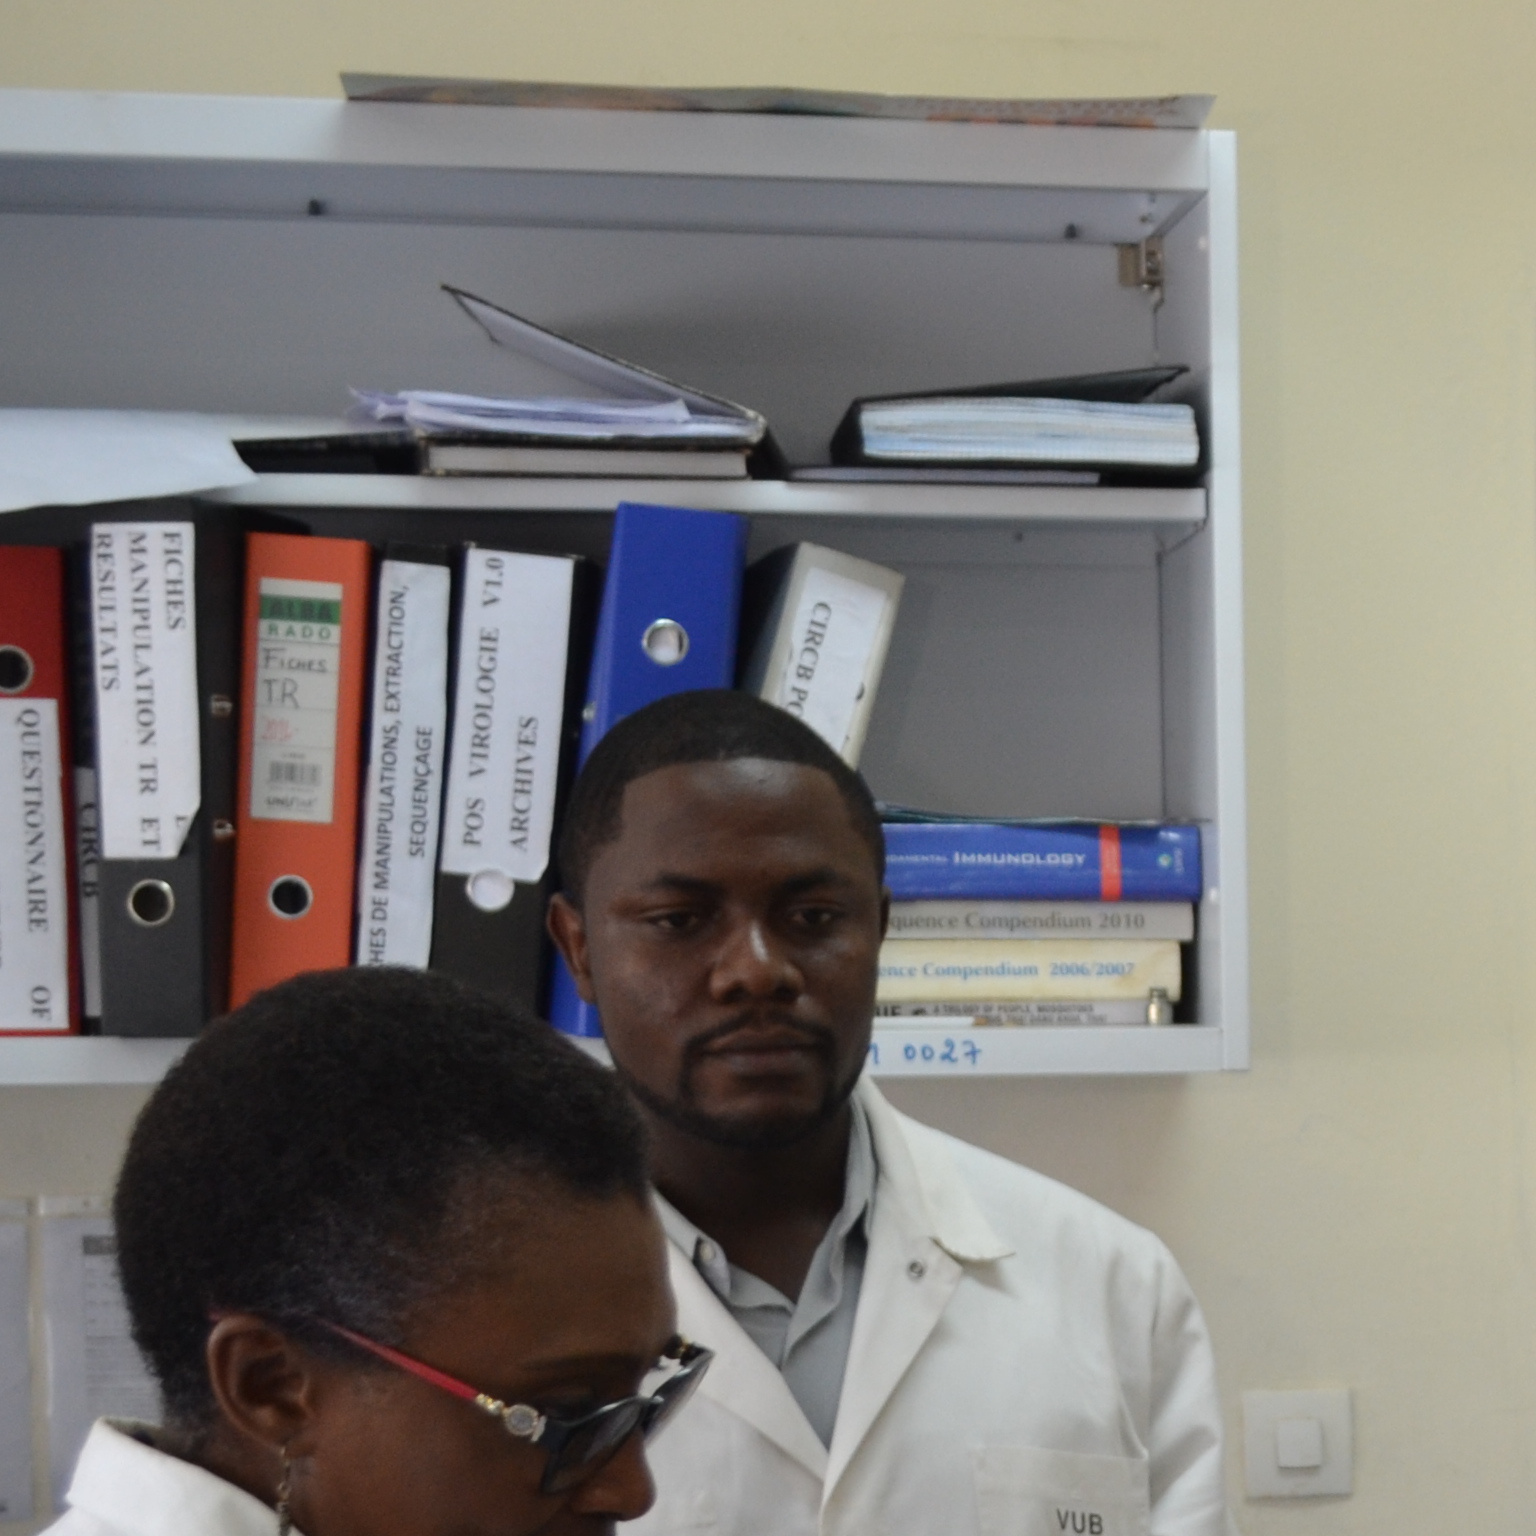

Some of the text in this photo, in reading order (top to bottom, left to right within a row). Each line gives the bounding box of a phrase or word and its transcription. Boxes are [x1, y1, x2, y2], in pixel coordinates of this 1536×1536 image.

[97, 532, 118, 692] RESULTATS
[163, 532, 186, 630] FICHES
[268, 623, 331, 640] RADO
[384, 584, 410, 714] EXTRACTION,
[796, 601, 833, 681] CIRCB
[128, 531, 160, 849] MANIPULATION TR ET
[263, 678, 300, 709] TR
[463, 556, 505, 848] POS VIROLOGIE V1.0
[16, 708, 49, 932] QUESTIONNAIRE
[373, 724, 403, 891] MANIPULATIONS,
[409, 726, 434, 857] SEQUENÇAGE
[510, 716, 539, 853] ARCHIVES
[953, 851, 1087, 866] IMMUNOLOGY
[371, 897, 389, 921] DE
[888, 911, 1146, 932] quence Compendium 2010
[878, 961, 1135, 981] ence Compendium 2006/2007
[903, 1038, 983, 1066] 0027
[1056, 1508, 1104, 1535] VUB
